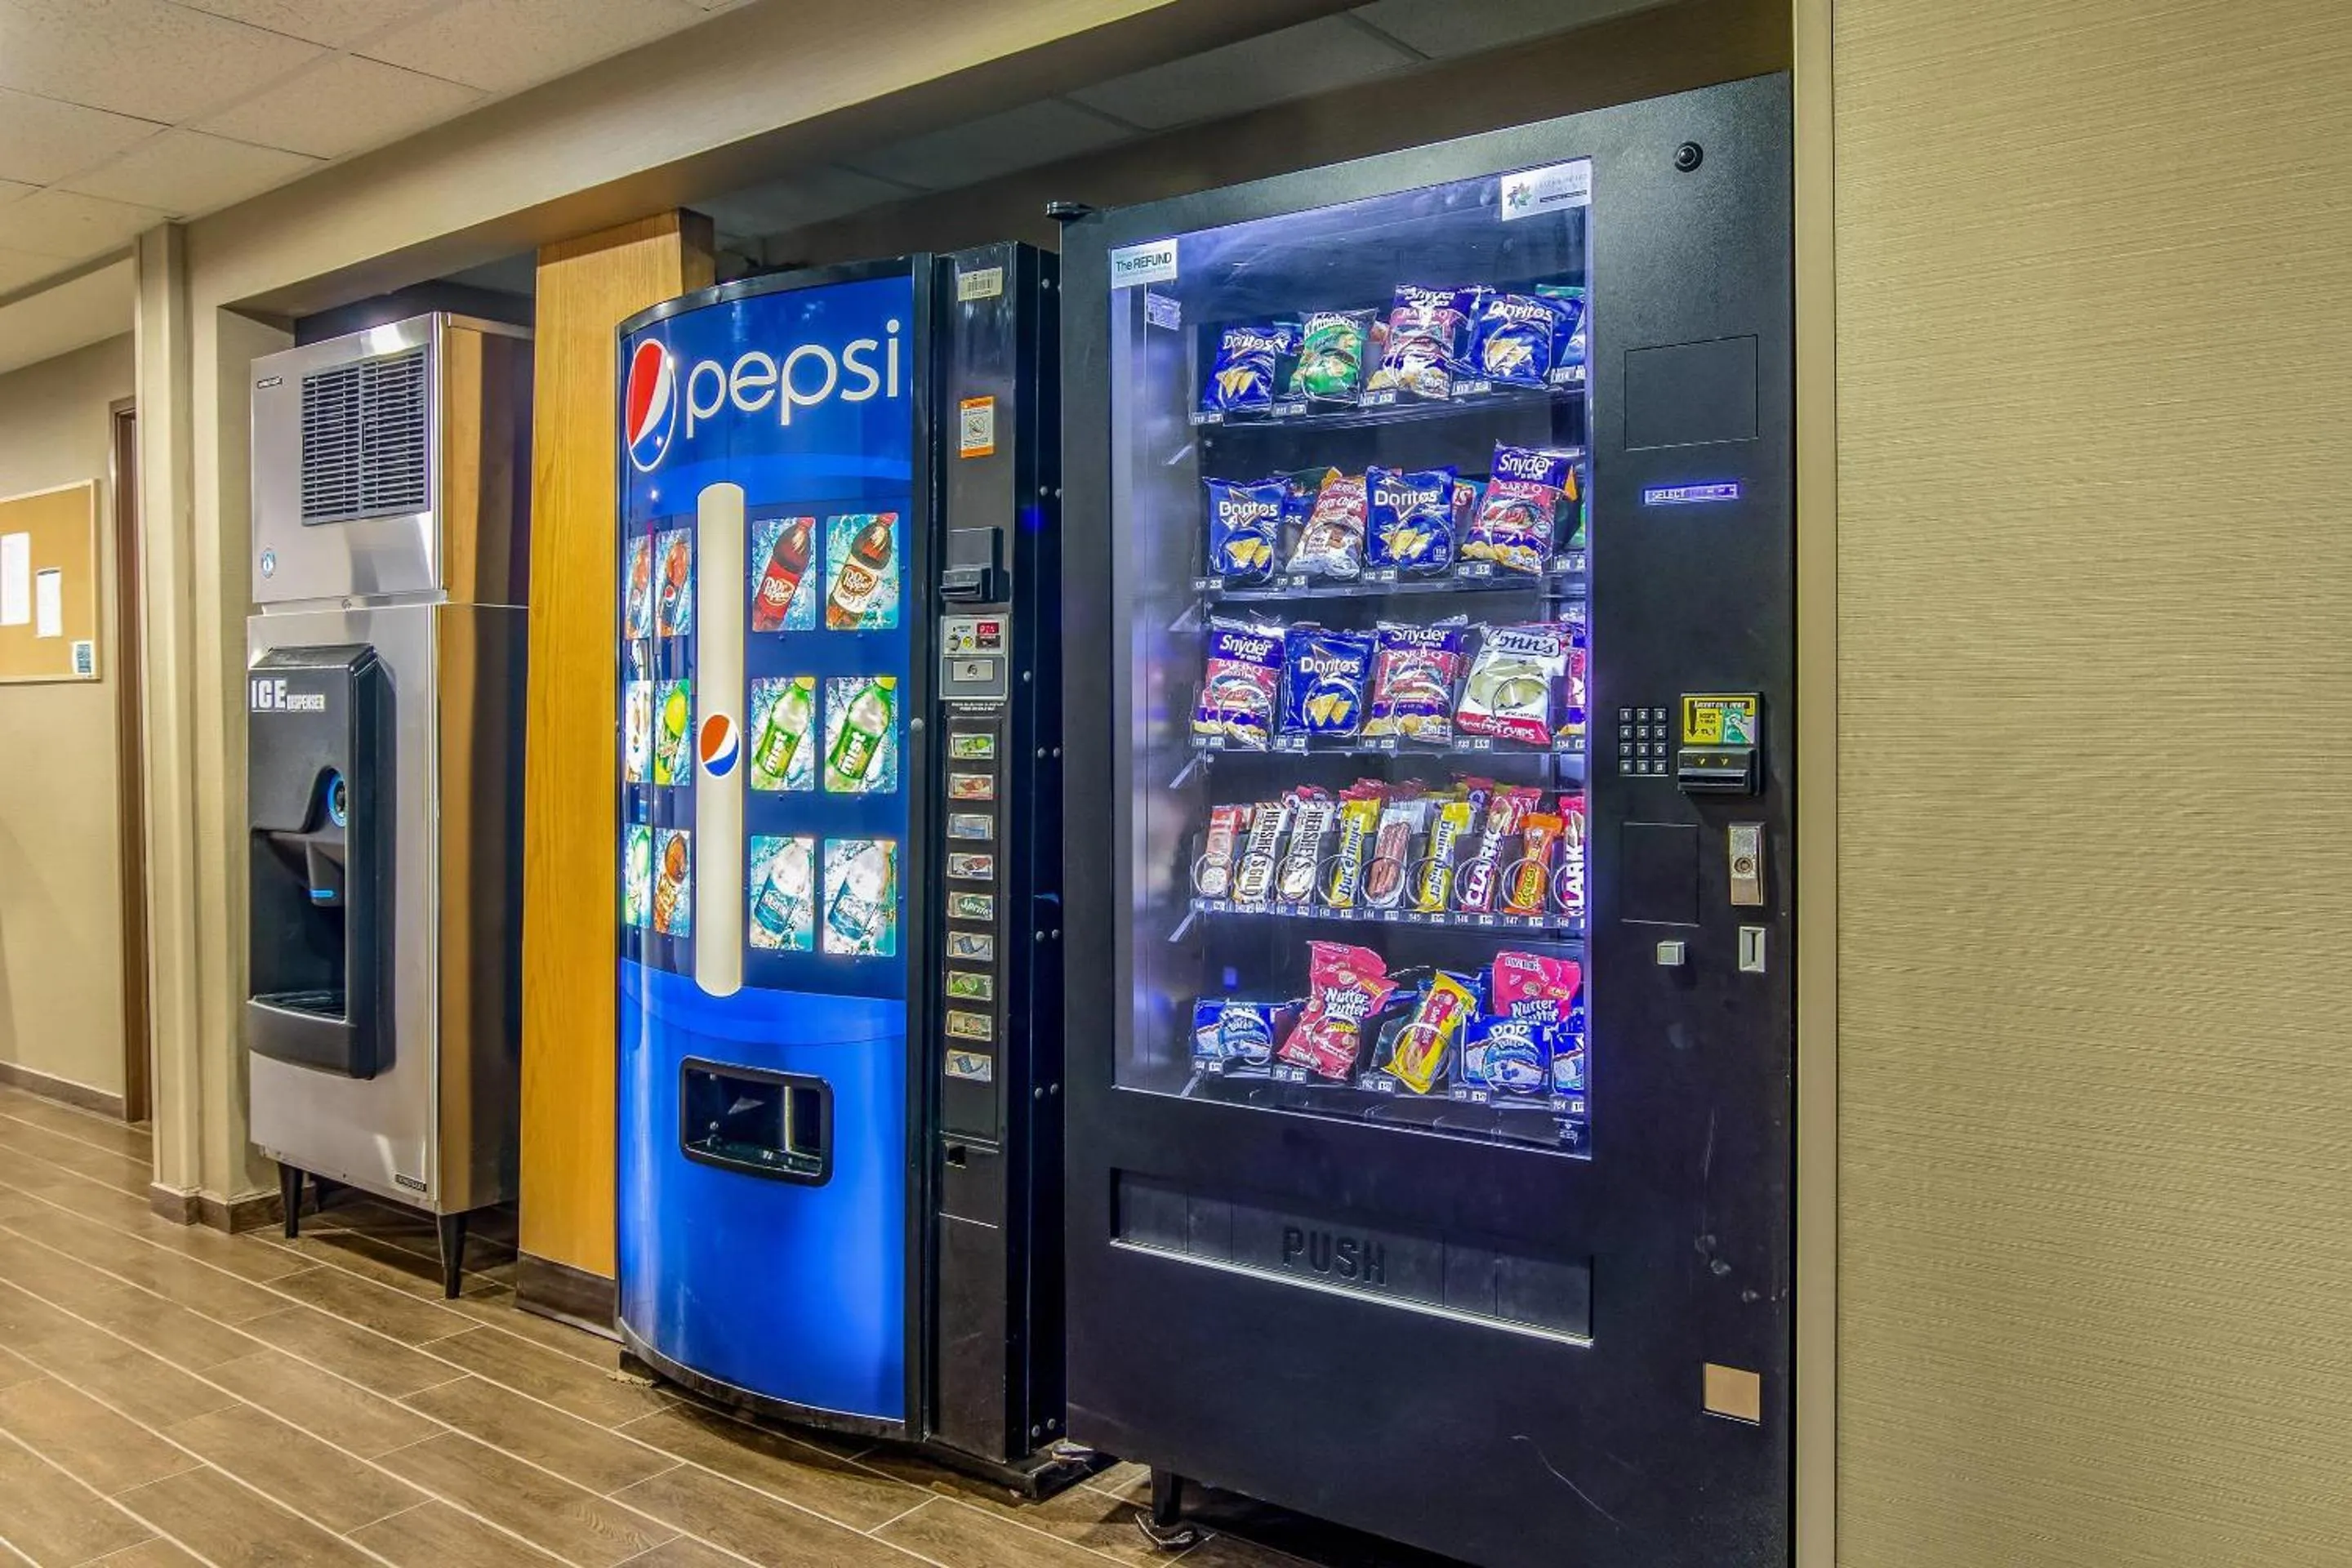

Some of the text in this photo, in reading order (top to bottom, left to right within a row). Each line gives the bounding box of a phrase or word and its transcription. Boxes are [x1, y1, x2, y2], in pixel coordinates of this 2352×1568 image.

[1116, 261, 1132, 272] The
[1134, 252, 1172, 269] REFUND
[1488, 301, 1552, 320] Doritos
[686, 319, 899, 439] pepsi
[1374, 491, 1437, 506] Doritos
[1219, 501, 1278, 516] Doritos
[1391, 628, 1450, 644] Snyder
[1219, 634, 1274, 657] Snyder
[1300, 657, 1360, 675] Doritos
[252, 680, 286, 708] ICE
[1465, 826, 1502, 906] CLARK
[1325, 987, 1370, 1003] Nutter
[1325, 1003, 1370, 1017] Butter
[1511, 1000, 1556, 1018] Nutter
[1282, 1226, 1387, 1287] PUSH
